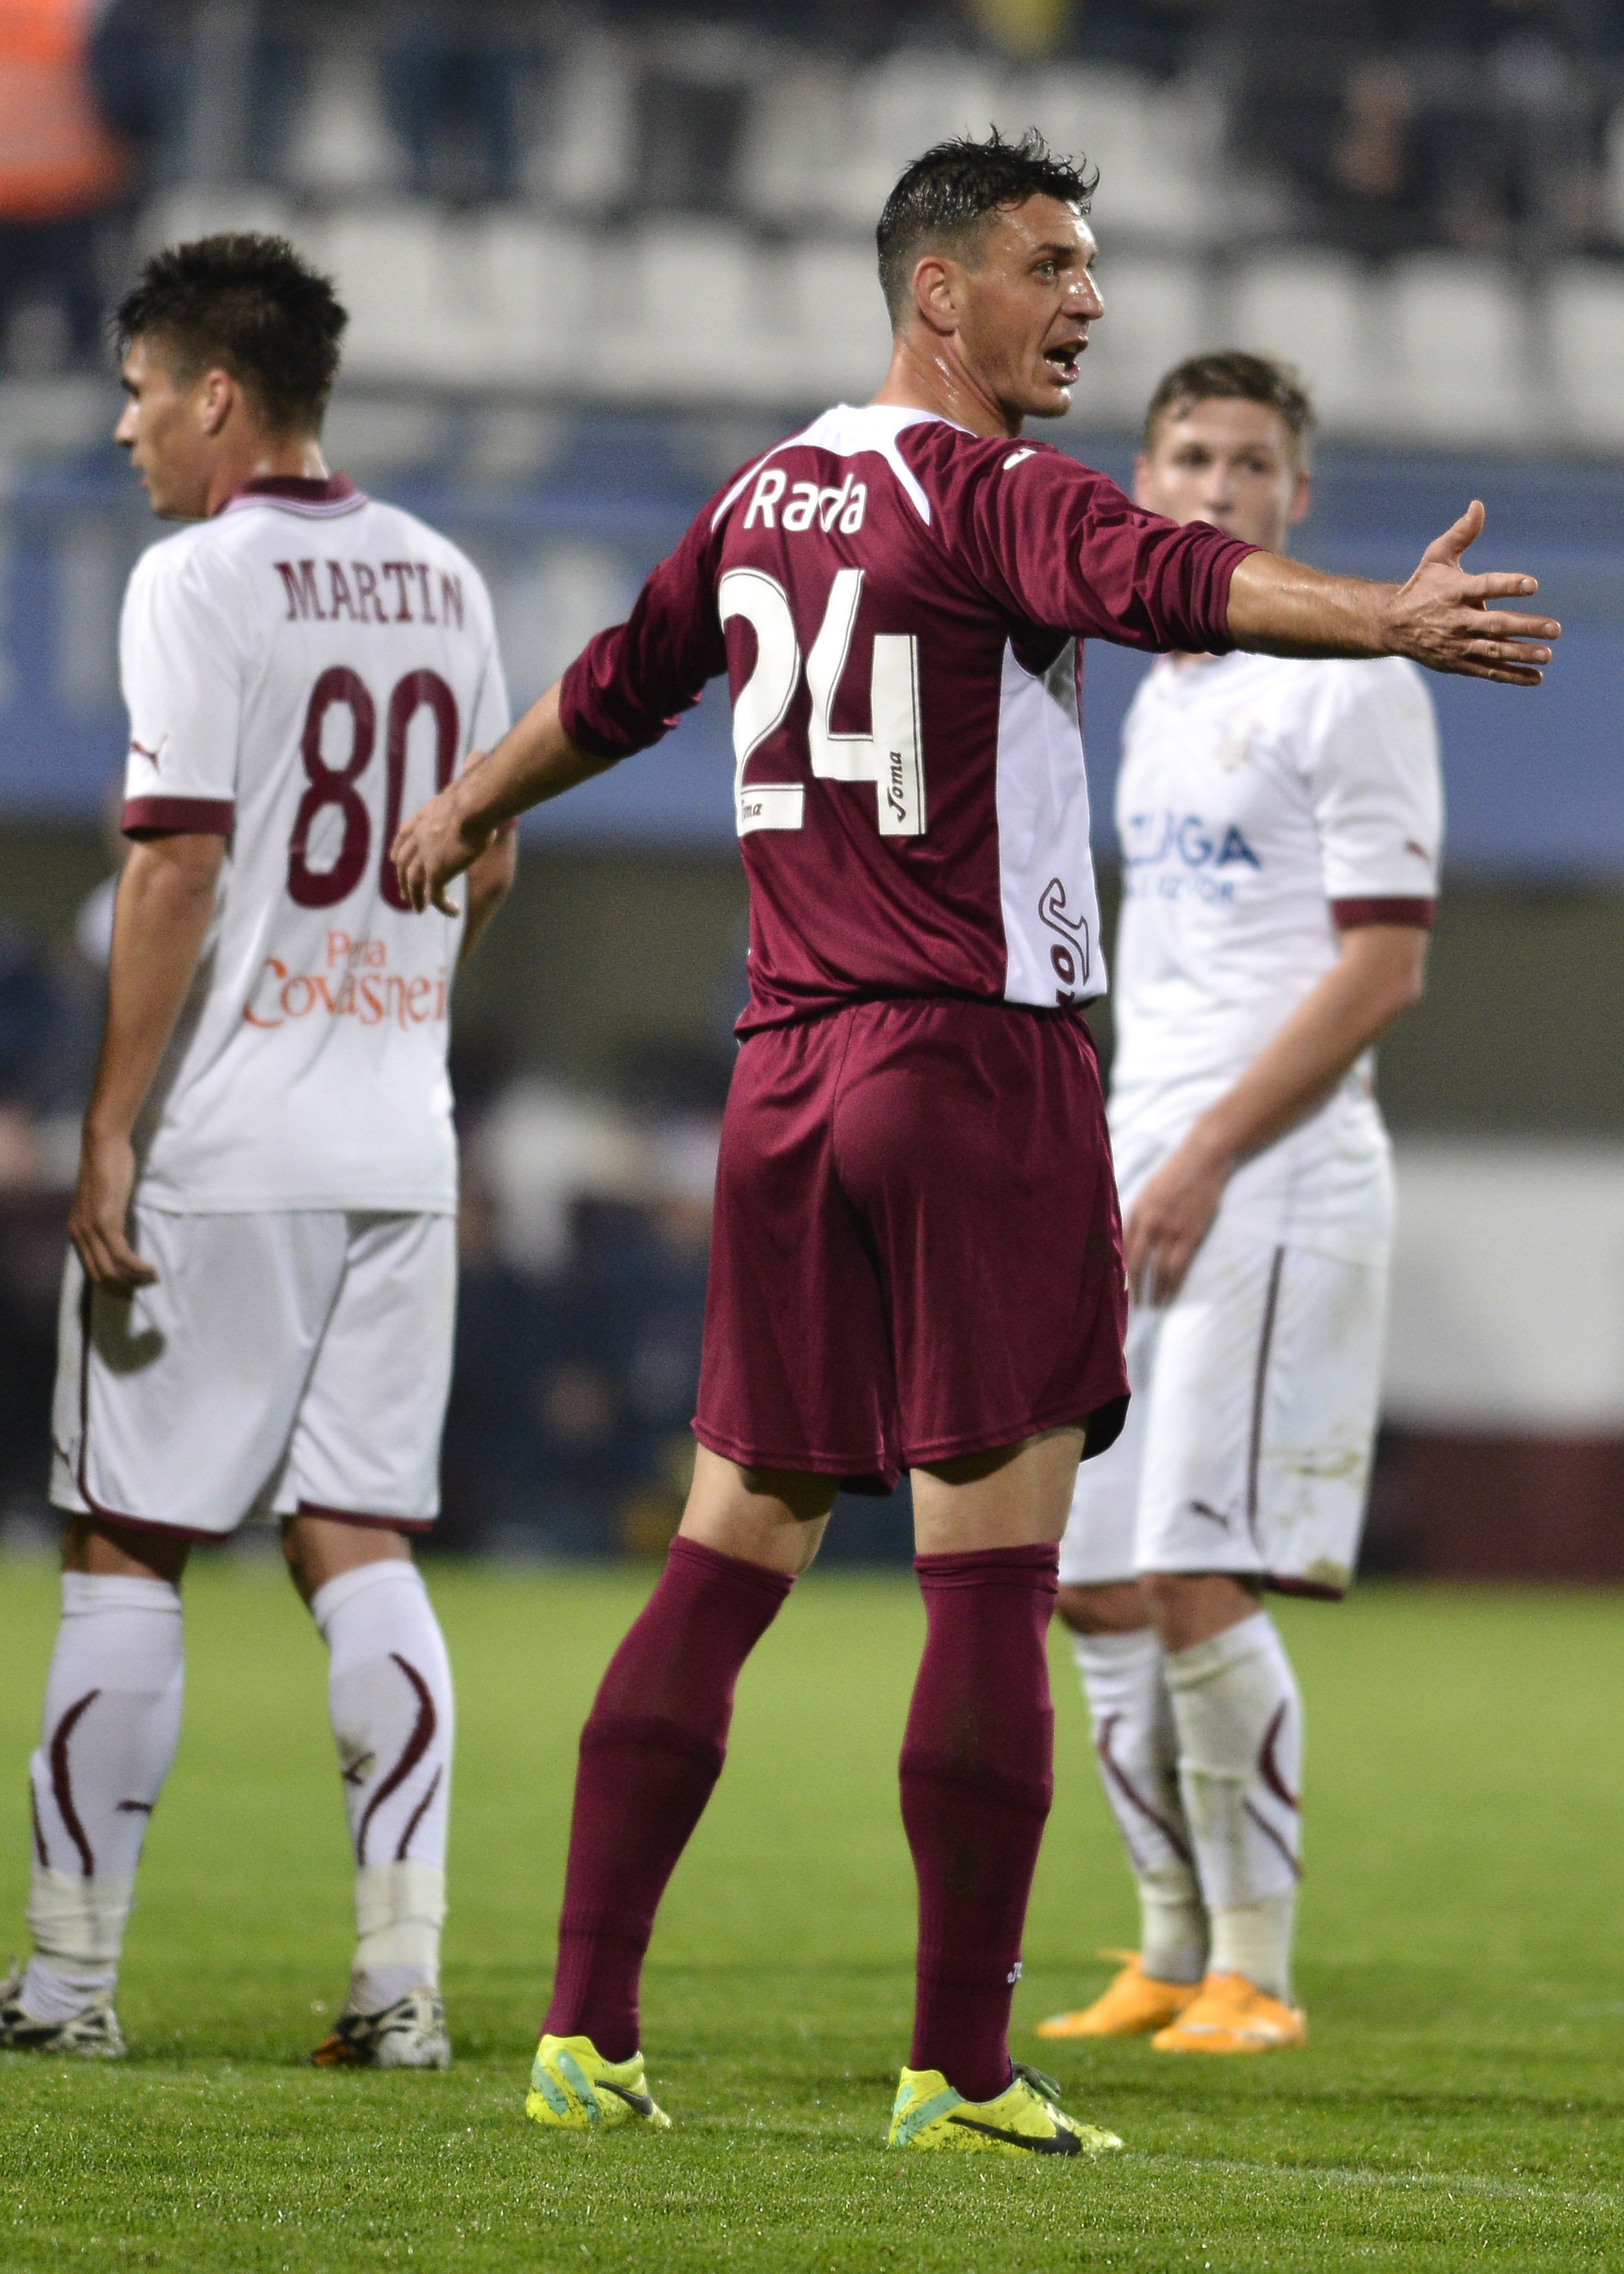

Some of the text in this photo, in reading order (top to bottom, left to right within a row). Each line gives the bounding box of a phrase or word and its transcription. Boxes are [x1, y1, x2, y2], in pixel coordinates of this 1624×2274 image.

[743, 470, 867, 534] Rada
[274, 558, 463, 632] MARTIN
[718, 567, 927, 837] 24
[288, 665, 460, 912] 80
[886, 750, 906, 824] Joma
